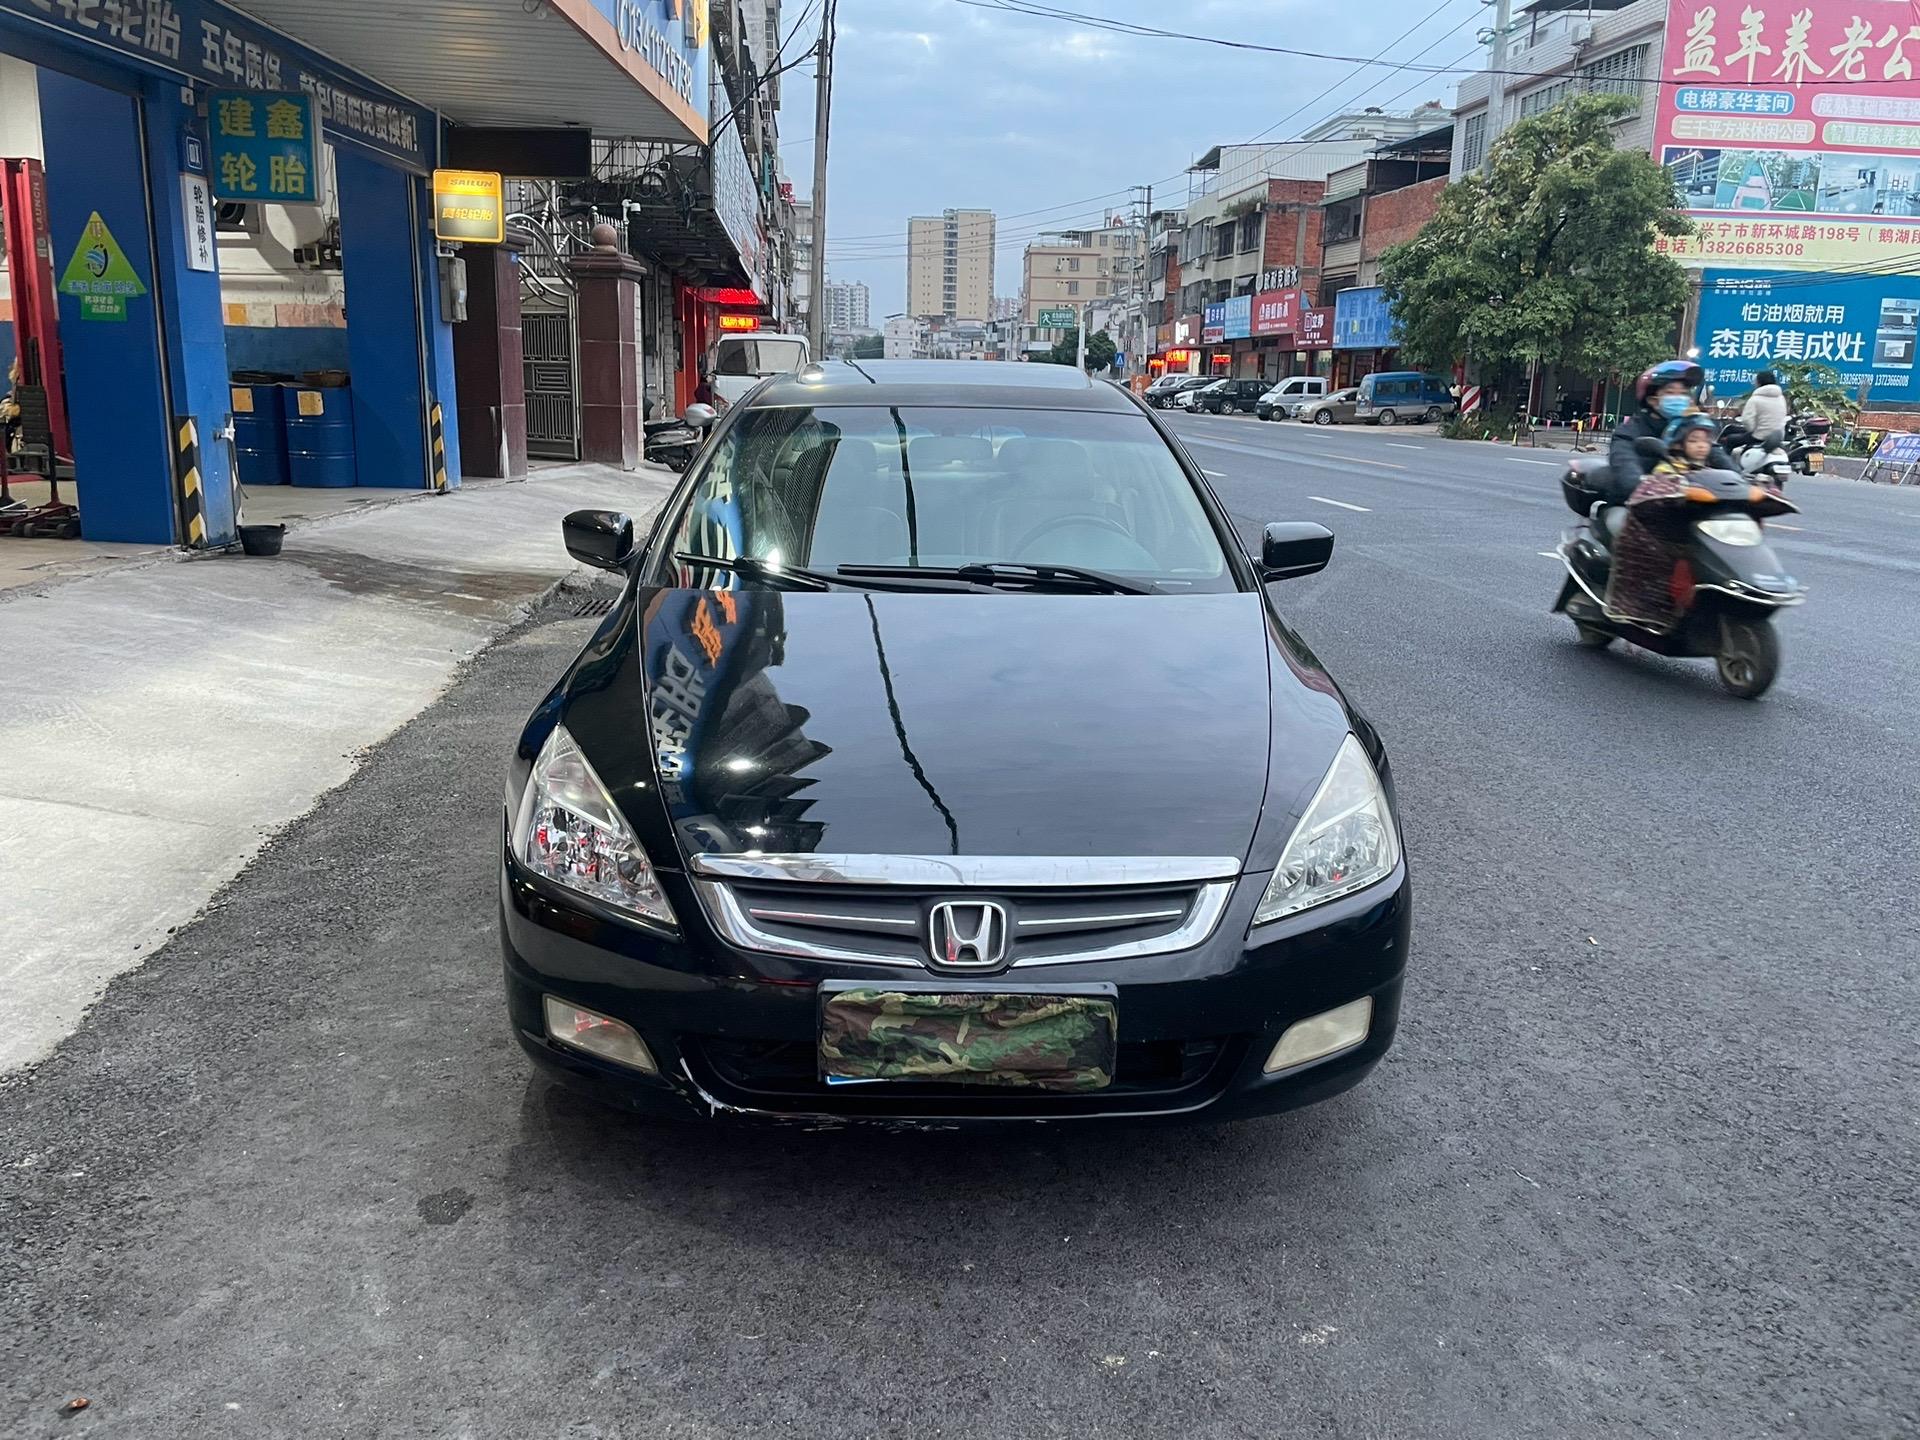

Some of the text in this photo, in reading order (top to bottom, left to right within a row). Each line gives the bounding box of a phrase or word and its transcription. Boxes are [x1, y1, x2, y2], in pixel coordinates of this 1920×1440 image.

[1673, 5, 1920, 89] 益年养老公
[218, 97, 304, 139] 建鑫
[1683, 90, 1789, 112] 电梯豪华套间
[220, 152, 307, 194] 轮胎
[193, 184, 208, 264] 轮胎修补
[1742, 303, 1845, 324] 怕油烟就用
[1709, 328, 1866, 362] 森歌集成灶
